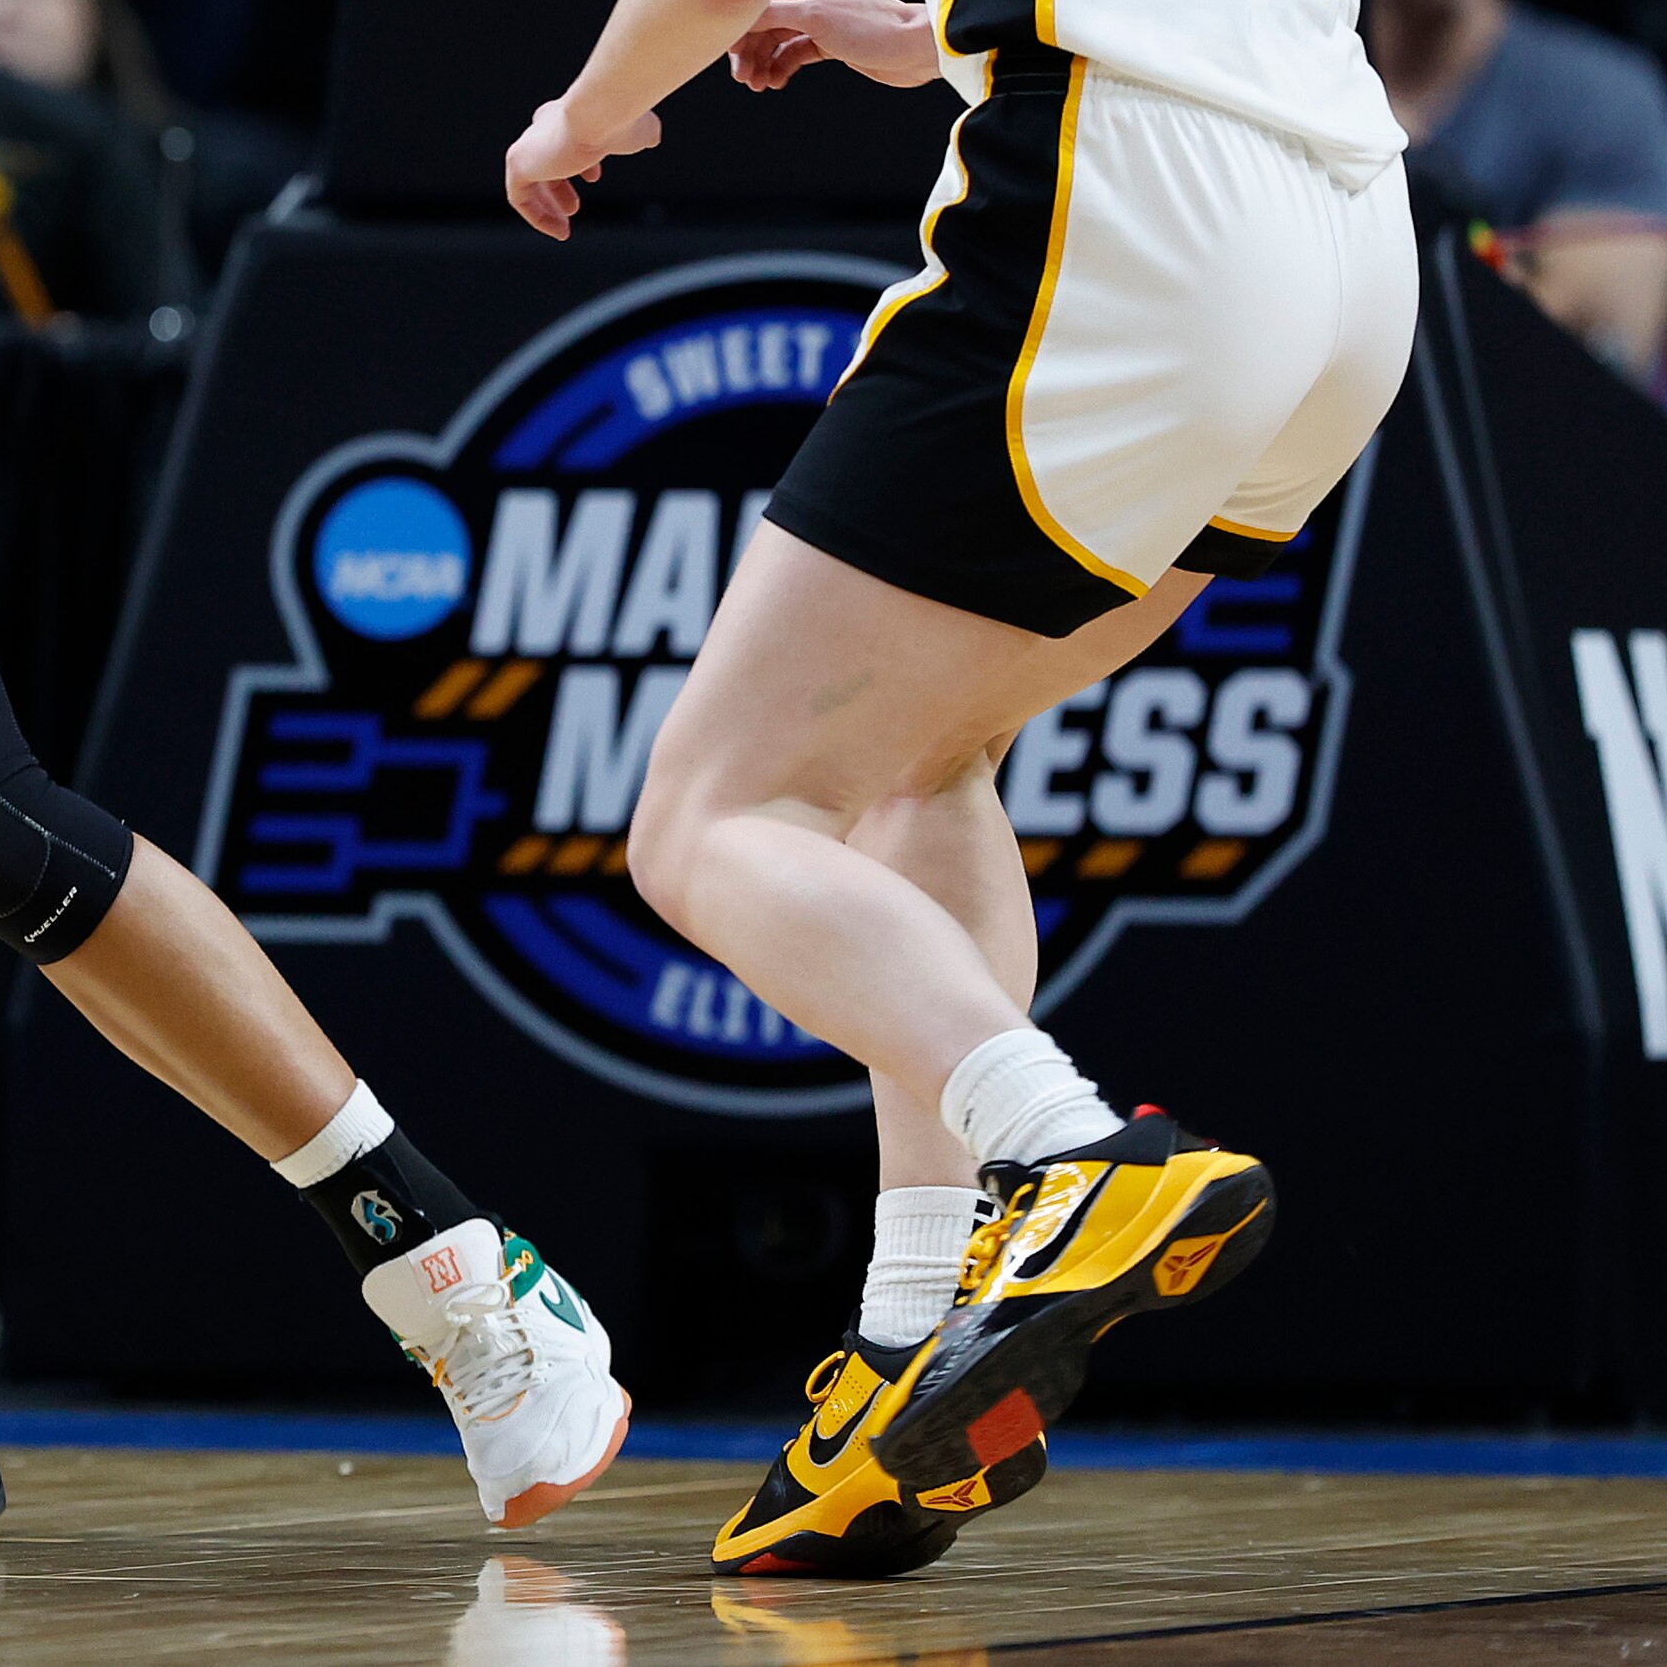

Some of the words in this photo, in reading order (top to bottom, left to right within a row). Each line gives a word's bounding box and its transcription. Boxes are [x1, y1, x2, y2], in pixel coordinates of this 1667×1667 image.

[623, 320, 832, 421] SWEET
[533, 664, 1315, 836] MESS
[28, 886, 78, 940] MUELLER
[649, 960, 822, 1046] ELIT
